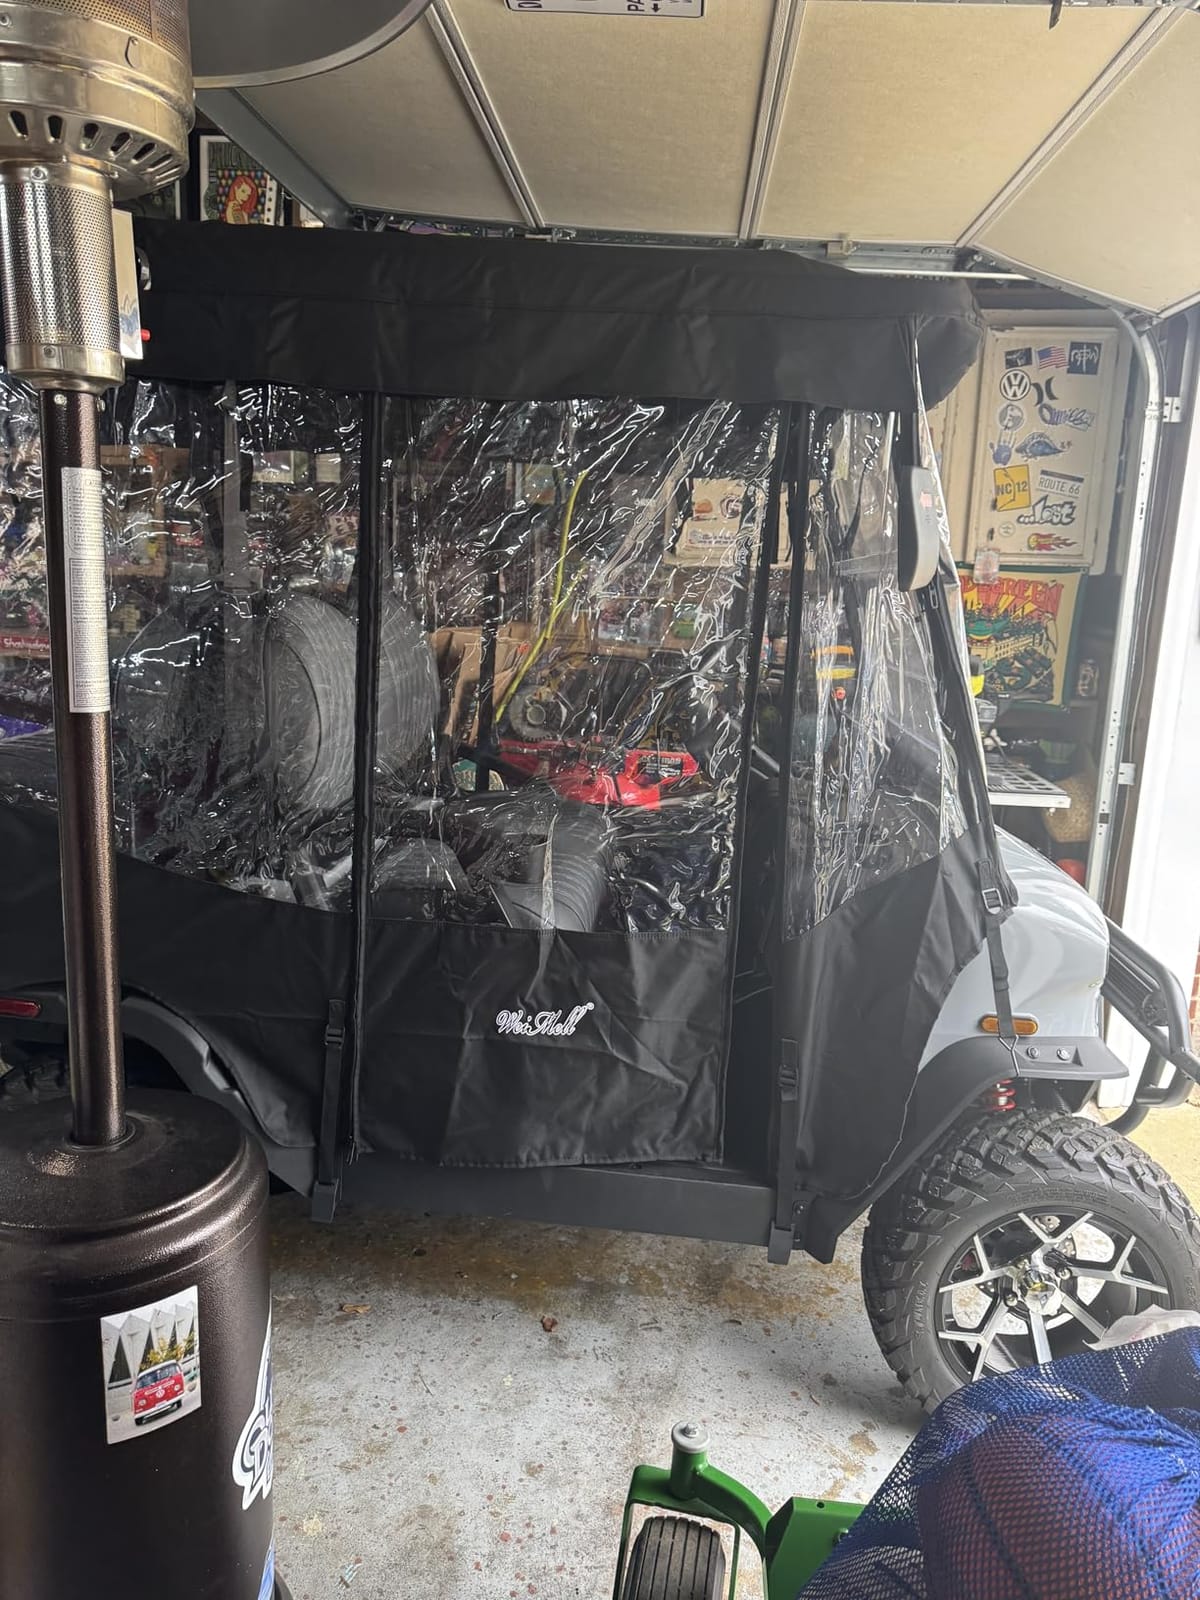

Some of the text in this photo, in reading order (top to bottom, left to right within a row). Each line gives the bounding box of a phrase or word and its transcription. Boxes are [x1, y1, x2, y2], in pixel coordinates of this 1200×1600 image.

[994, 481, 1027, 496] NC 12
[1038, 477, 1080, 495] ROUTE 66
